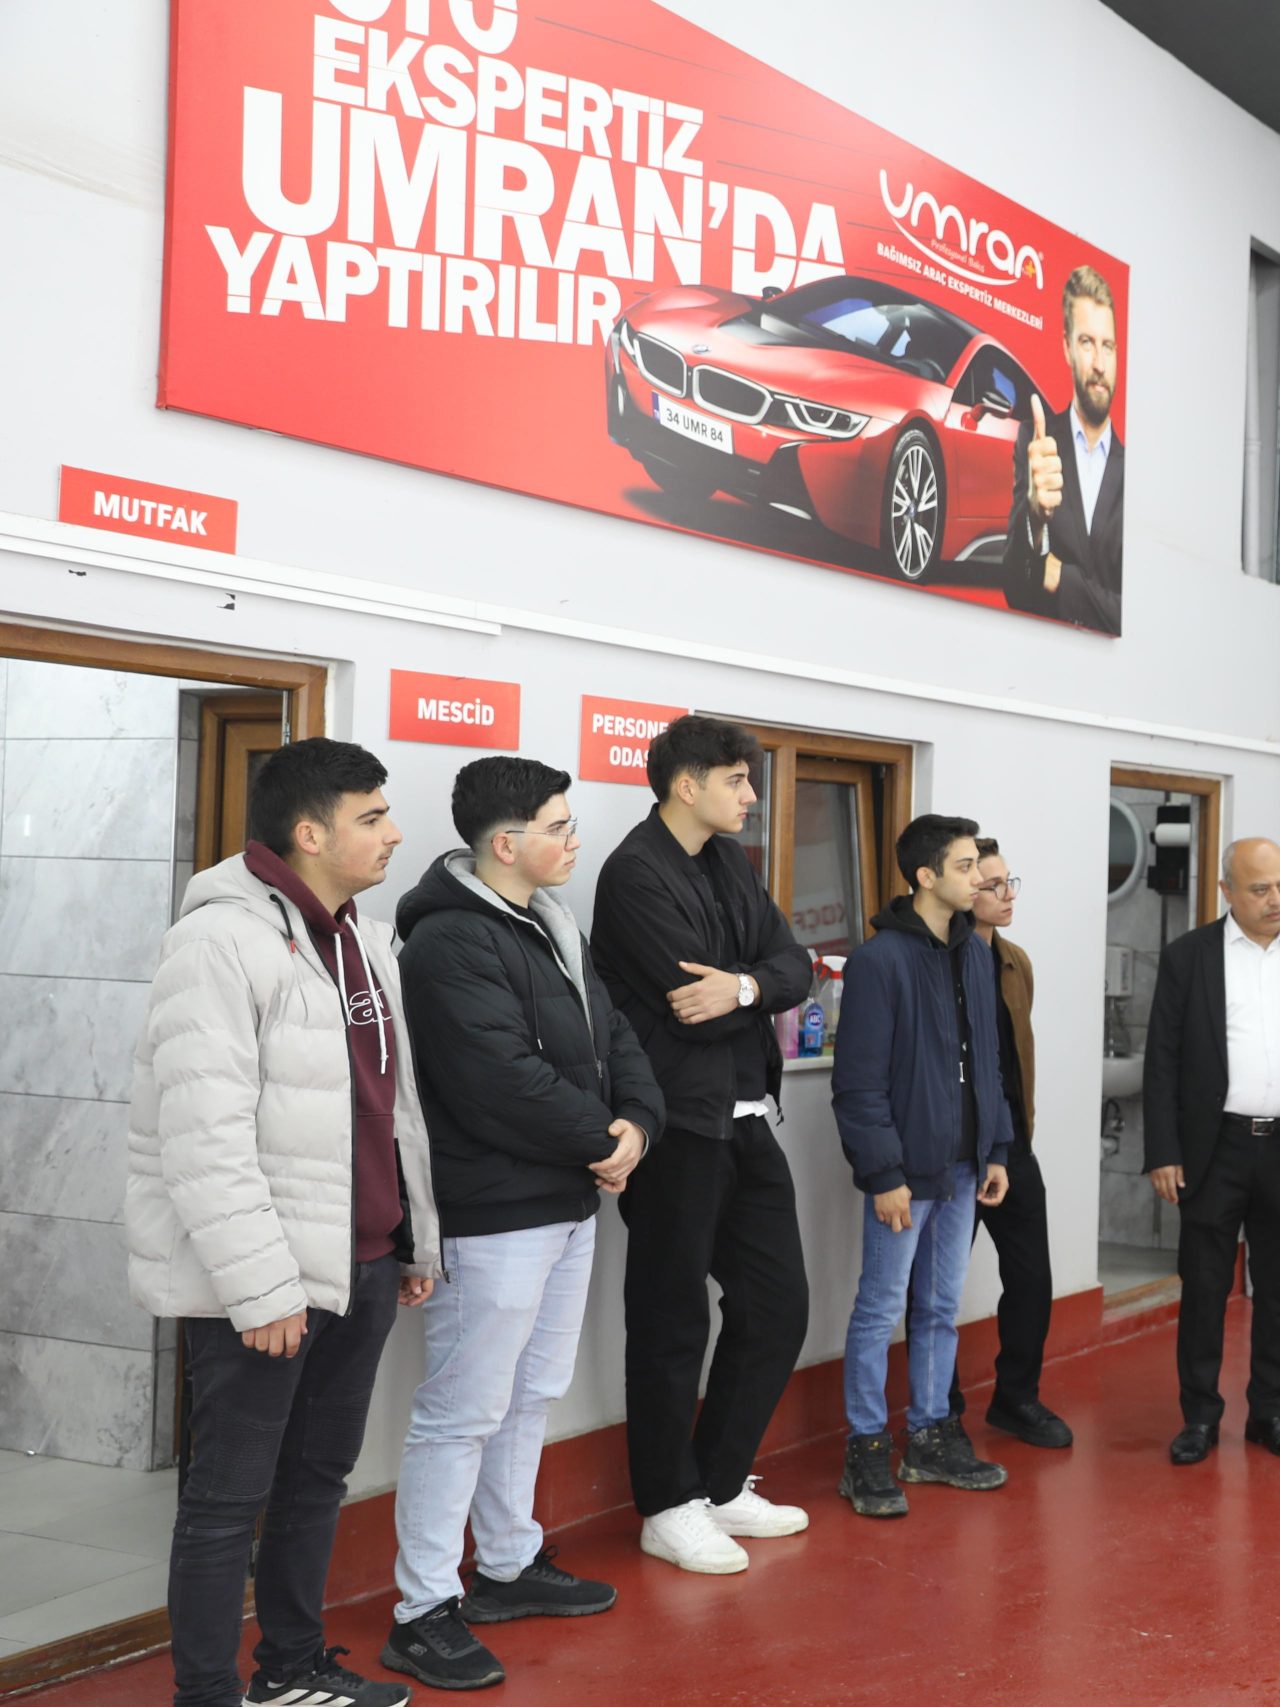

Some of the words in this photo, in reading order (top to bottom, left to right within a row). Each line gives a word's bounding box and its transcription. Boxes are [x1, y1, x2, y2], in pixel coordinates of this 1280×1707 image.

[242, 86, 847, 298] UMRAN'DA
[879, 168, 1043, 289] umran
[204, 225, 623, 347] YAPTIRILIR
[923, 265, 947, 286] ARAÇ
[666, 408, 680, 425] 34
[683, 415, 708, 438] UMR
[710, 427, 724, 443] 84
[94, 490, 208, 536] MUTFAK
[418, 697, 495, 726] MESCİD
[592, 713, 669, 740] PERSONE
[609, 745, 649, 768] ODA
